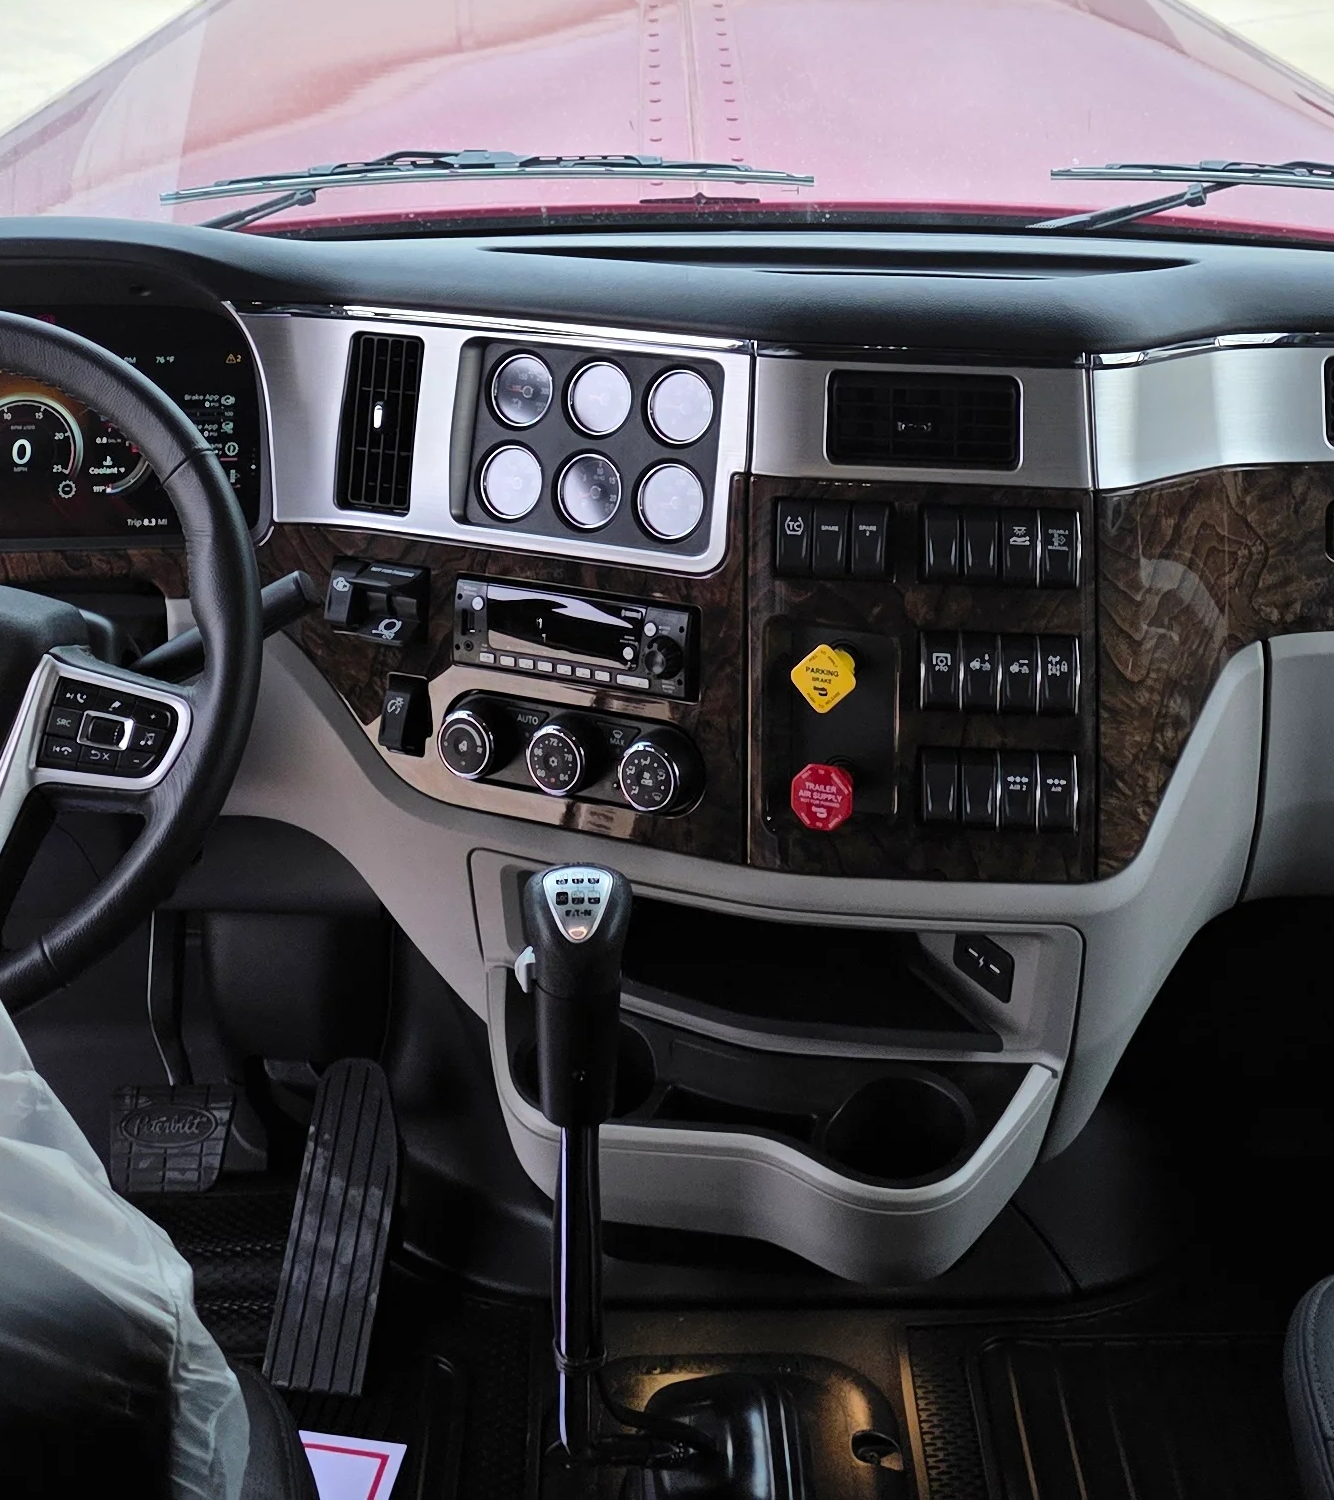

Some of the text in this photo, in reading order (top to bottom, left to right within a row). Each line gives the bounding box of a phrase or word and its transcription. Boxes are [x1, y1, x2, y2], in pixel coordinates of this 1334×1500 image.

[155, 356, 165, 364] 76
[54, 432, 65, 440] 20
[12, 438, 32, 465] 0
[52, 465, 63, 473] 25
[89, 466, 118, 475] Coolant
[127, 518, 142, 528] Trip
[788, 521, 801, 531] TC
[805, 665, 839, 678] PARKING
[934, 665, 949, 673] PTO
[811, 676, 832, 685] BRAKE
[56, 717, 72, 728] SRC
[517, 713, 539, 725] AUTO
[549, 737, 559, 747] 72
[610, 737, 626, 747] MAX
[805, 781, 837, 793] TRAILER
[798, 789, 843, 803] AIR SUPPLY
[133, 1114, 203, 1136] Peterbilt
